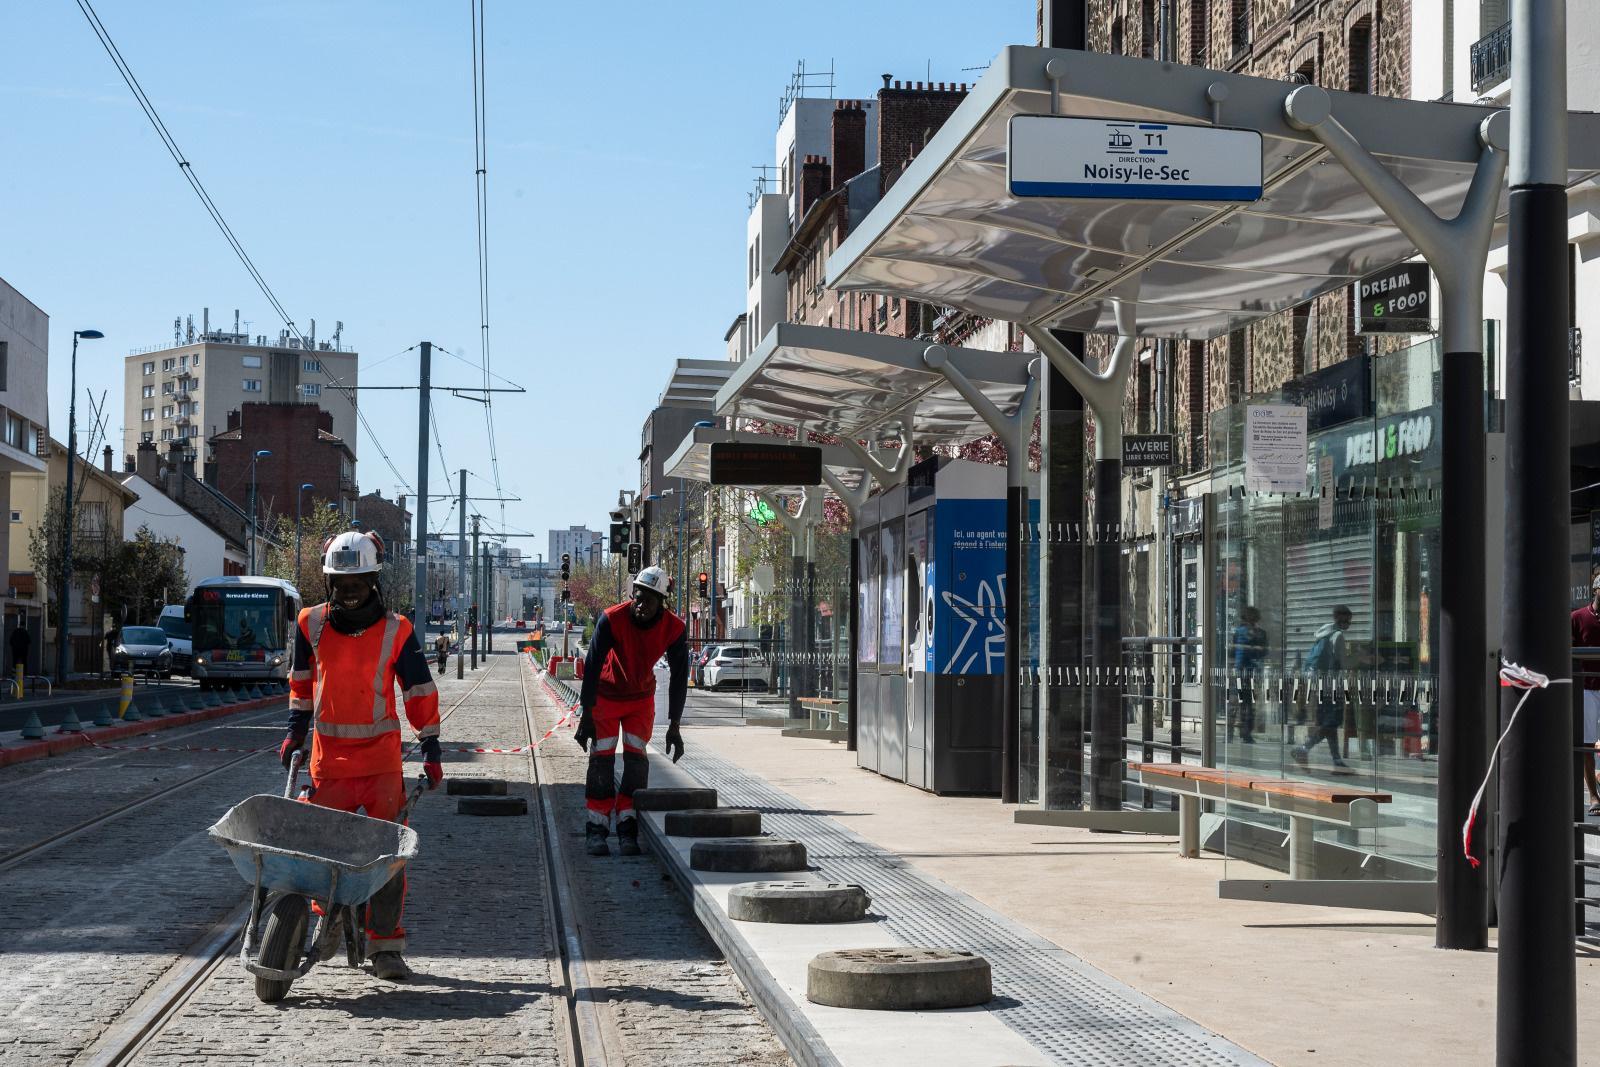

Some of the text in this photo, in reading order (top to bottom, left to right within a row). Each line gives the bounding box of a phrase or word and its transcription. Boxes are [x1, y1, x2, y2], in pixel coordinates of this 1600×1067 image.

[1144, 133, 1164, 146] T1
[1083, 163, 1190, 183] Noisy-le-Sec
[1361, 272, 1411, 298] DREAM
[1373, 290, 1427, 317] & FOOD
[1317, 385, 1337, 411] Noisy
[1125, 441, 1169, 452] LAVERIE
[954, 529, 965, 539] Ici,
[976, 530, 996, 540] agent
[954, 540, 978, 551] répond
